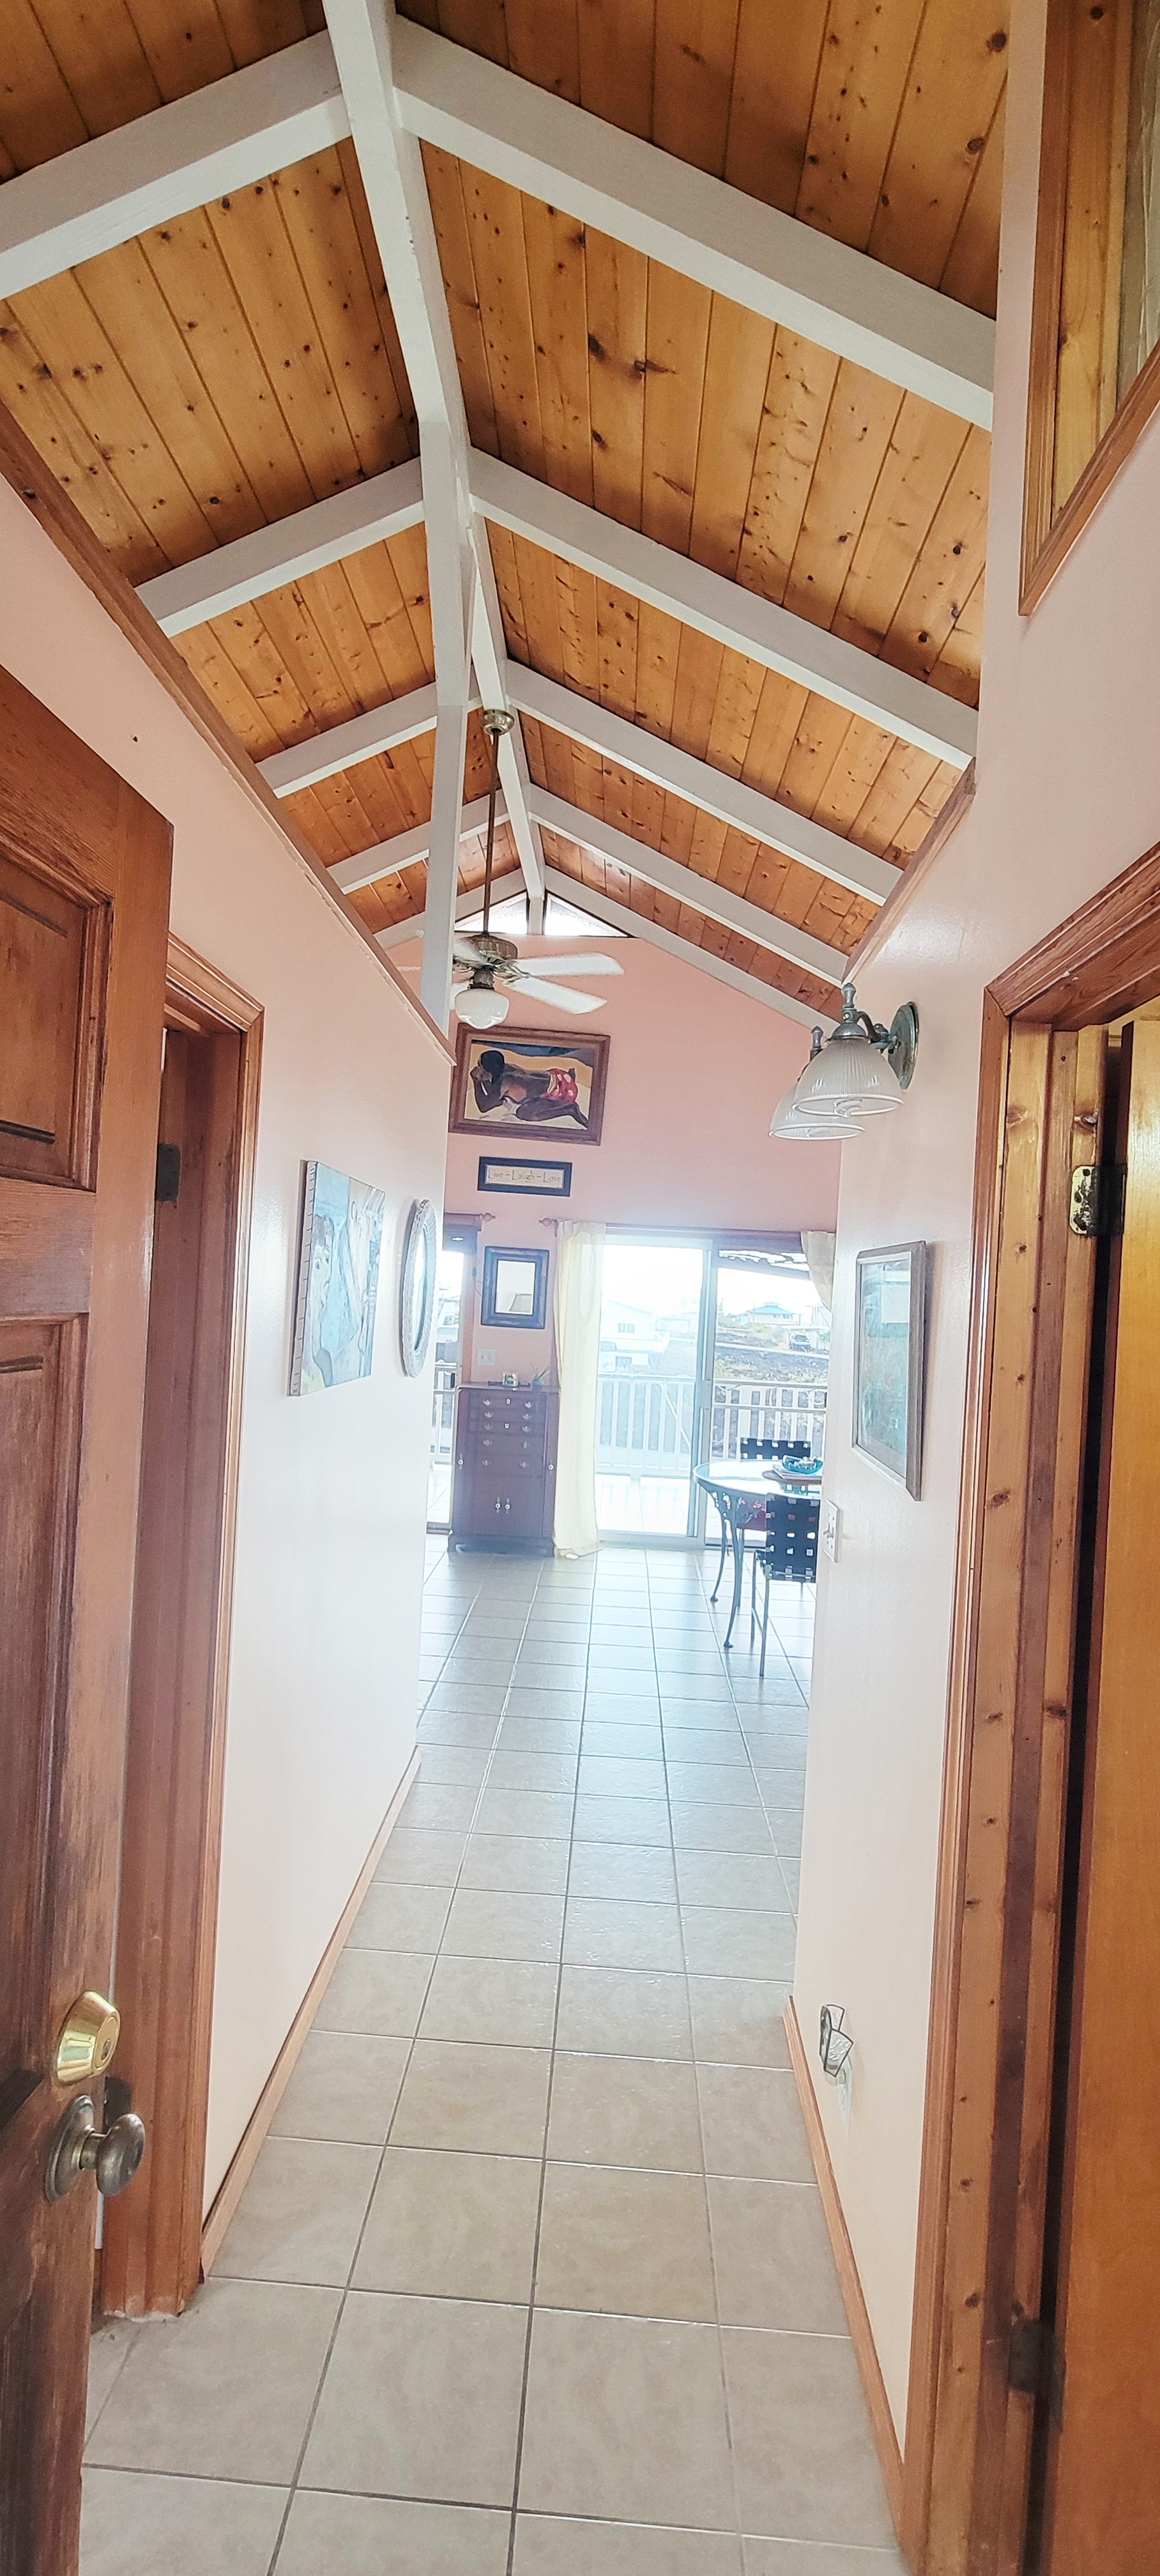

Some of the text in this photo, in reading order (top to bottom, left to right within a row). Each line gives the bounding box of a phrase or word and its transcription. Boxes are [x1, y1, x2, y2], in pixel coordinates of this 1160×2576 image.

[488, 1169, 503, 1179] Live
[512, 1170, 535, 1183] Laugh
[543, 1172, 561, 1183] Love
